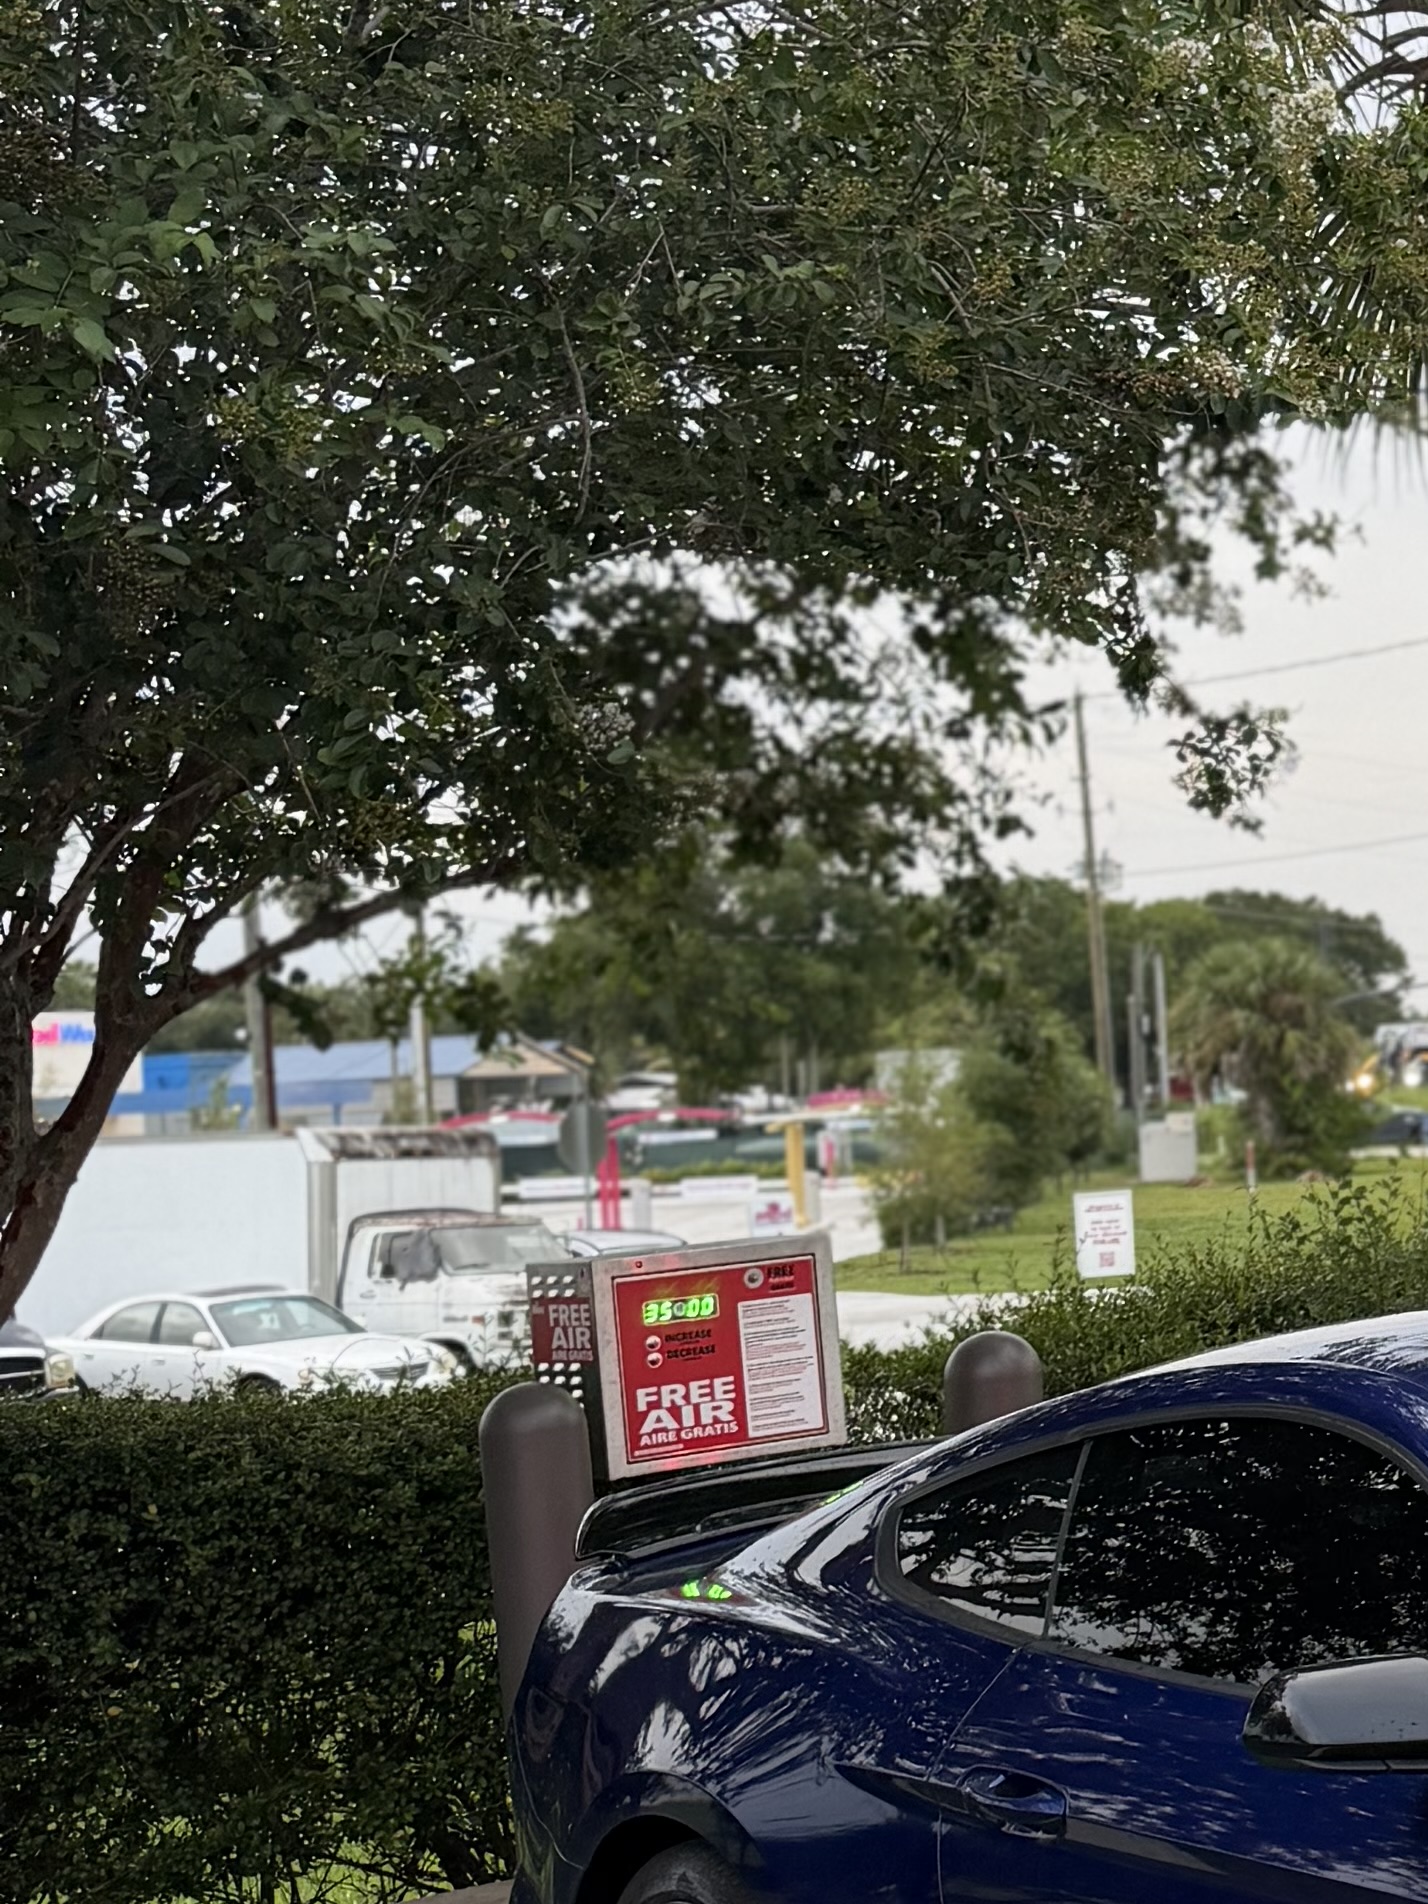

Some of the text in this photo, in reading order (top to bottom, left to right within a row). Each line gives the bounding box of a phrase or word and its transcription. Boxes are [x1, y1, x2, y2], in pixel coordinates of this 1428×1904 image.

[548, 1303, 591, 1327] FREE
[551, 1326, 591, 1349] AIR
[665, 1329, 712, 1343] INCREASE
[666, 1344, 716, 1359] DECREASE
[636, 1376, 736, 1412] FREE
[639, 1400, 735, 1434] AIR
[639, 1421, 739, 1447] AIRE GRATIS
